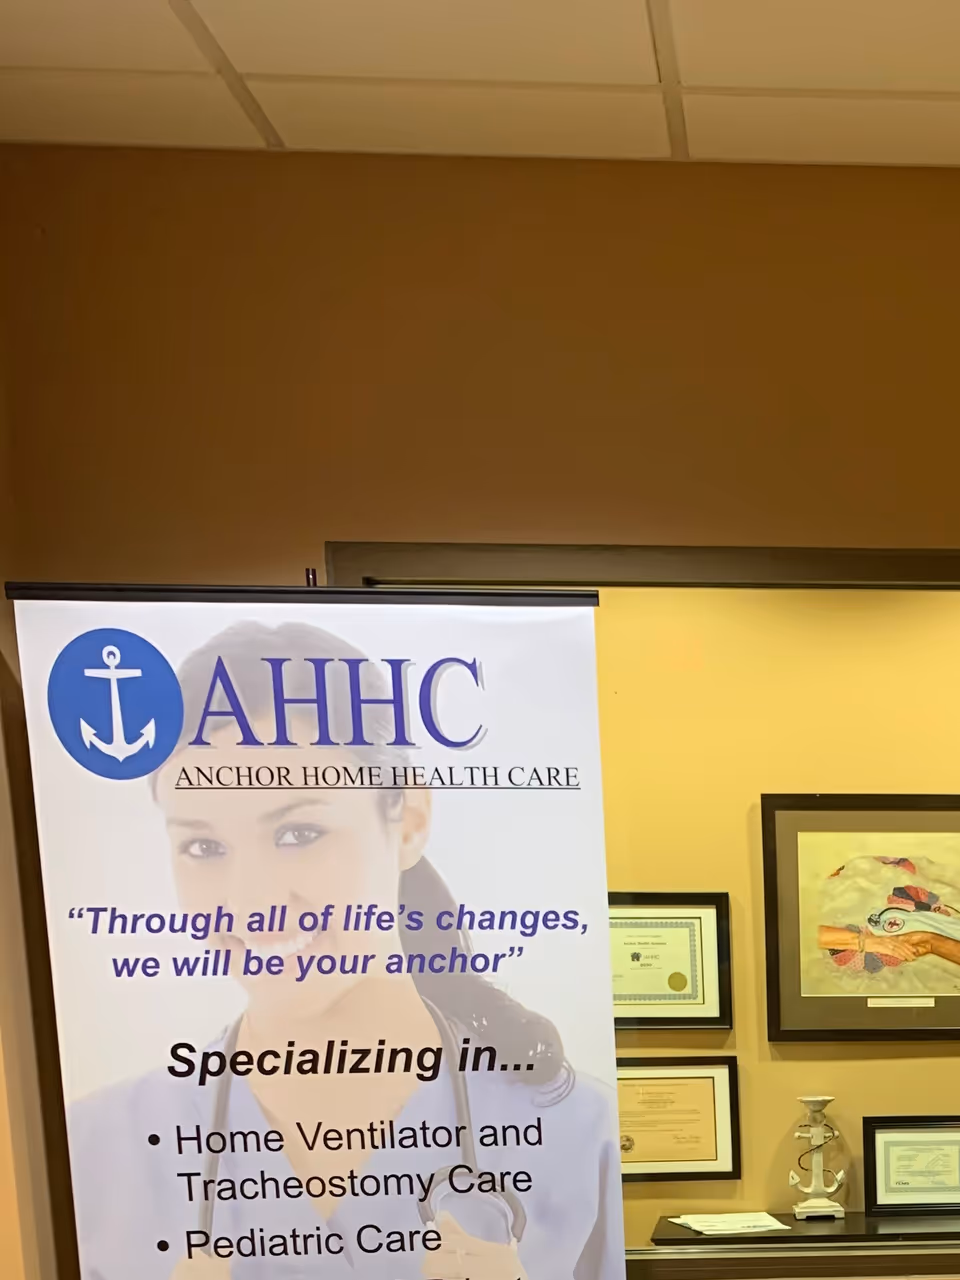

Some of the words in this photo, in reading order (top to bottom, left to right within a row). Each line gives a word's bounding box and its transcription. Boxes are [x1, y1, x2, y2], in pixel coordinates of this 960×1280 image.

[188, 655, 487, 750] AHHC
[175, 766, 294, 787] ANCHOR
[302, 766, 383, 787] HOME
[393, 766, 500, 787] HEALTH
[508, 766, 581, 787] CARE
[68, 905, 235, 938] “Through
[247, 906, 286, 932] all
[300, 904, 333, 931] of
[344, 903, 424, 932] life’s
[436, 904, 589, 937] changes,
[112, 955, 160, 977] we
[172, 949, 230, 976] will
[242, 949, 284, 975] be
[295, 955, 374, 982] your
[386, 946, 524, 974] anchor”
[167, 1040, 443, 1084] Specializing
[458, 1038, 535, 1072] in...
[175, 1124, 285, 1154] Home
[296, 1120, 467, 1151] Ventilator
[478, 1118, 543, 1147] and
[177, 1168, 435, 1202] Tracheostomy
[448, 1164, 533, 1193] Care
[185, 1226, 344, 1259] Pediatric
[356, 1224, 442, 1254] Care
